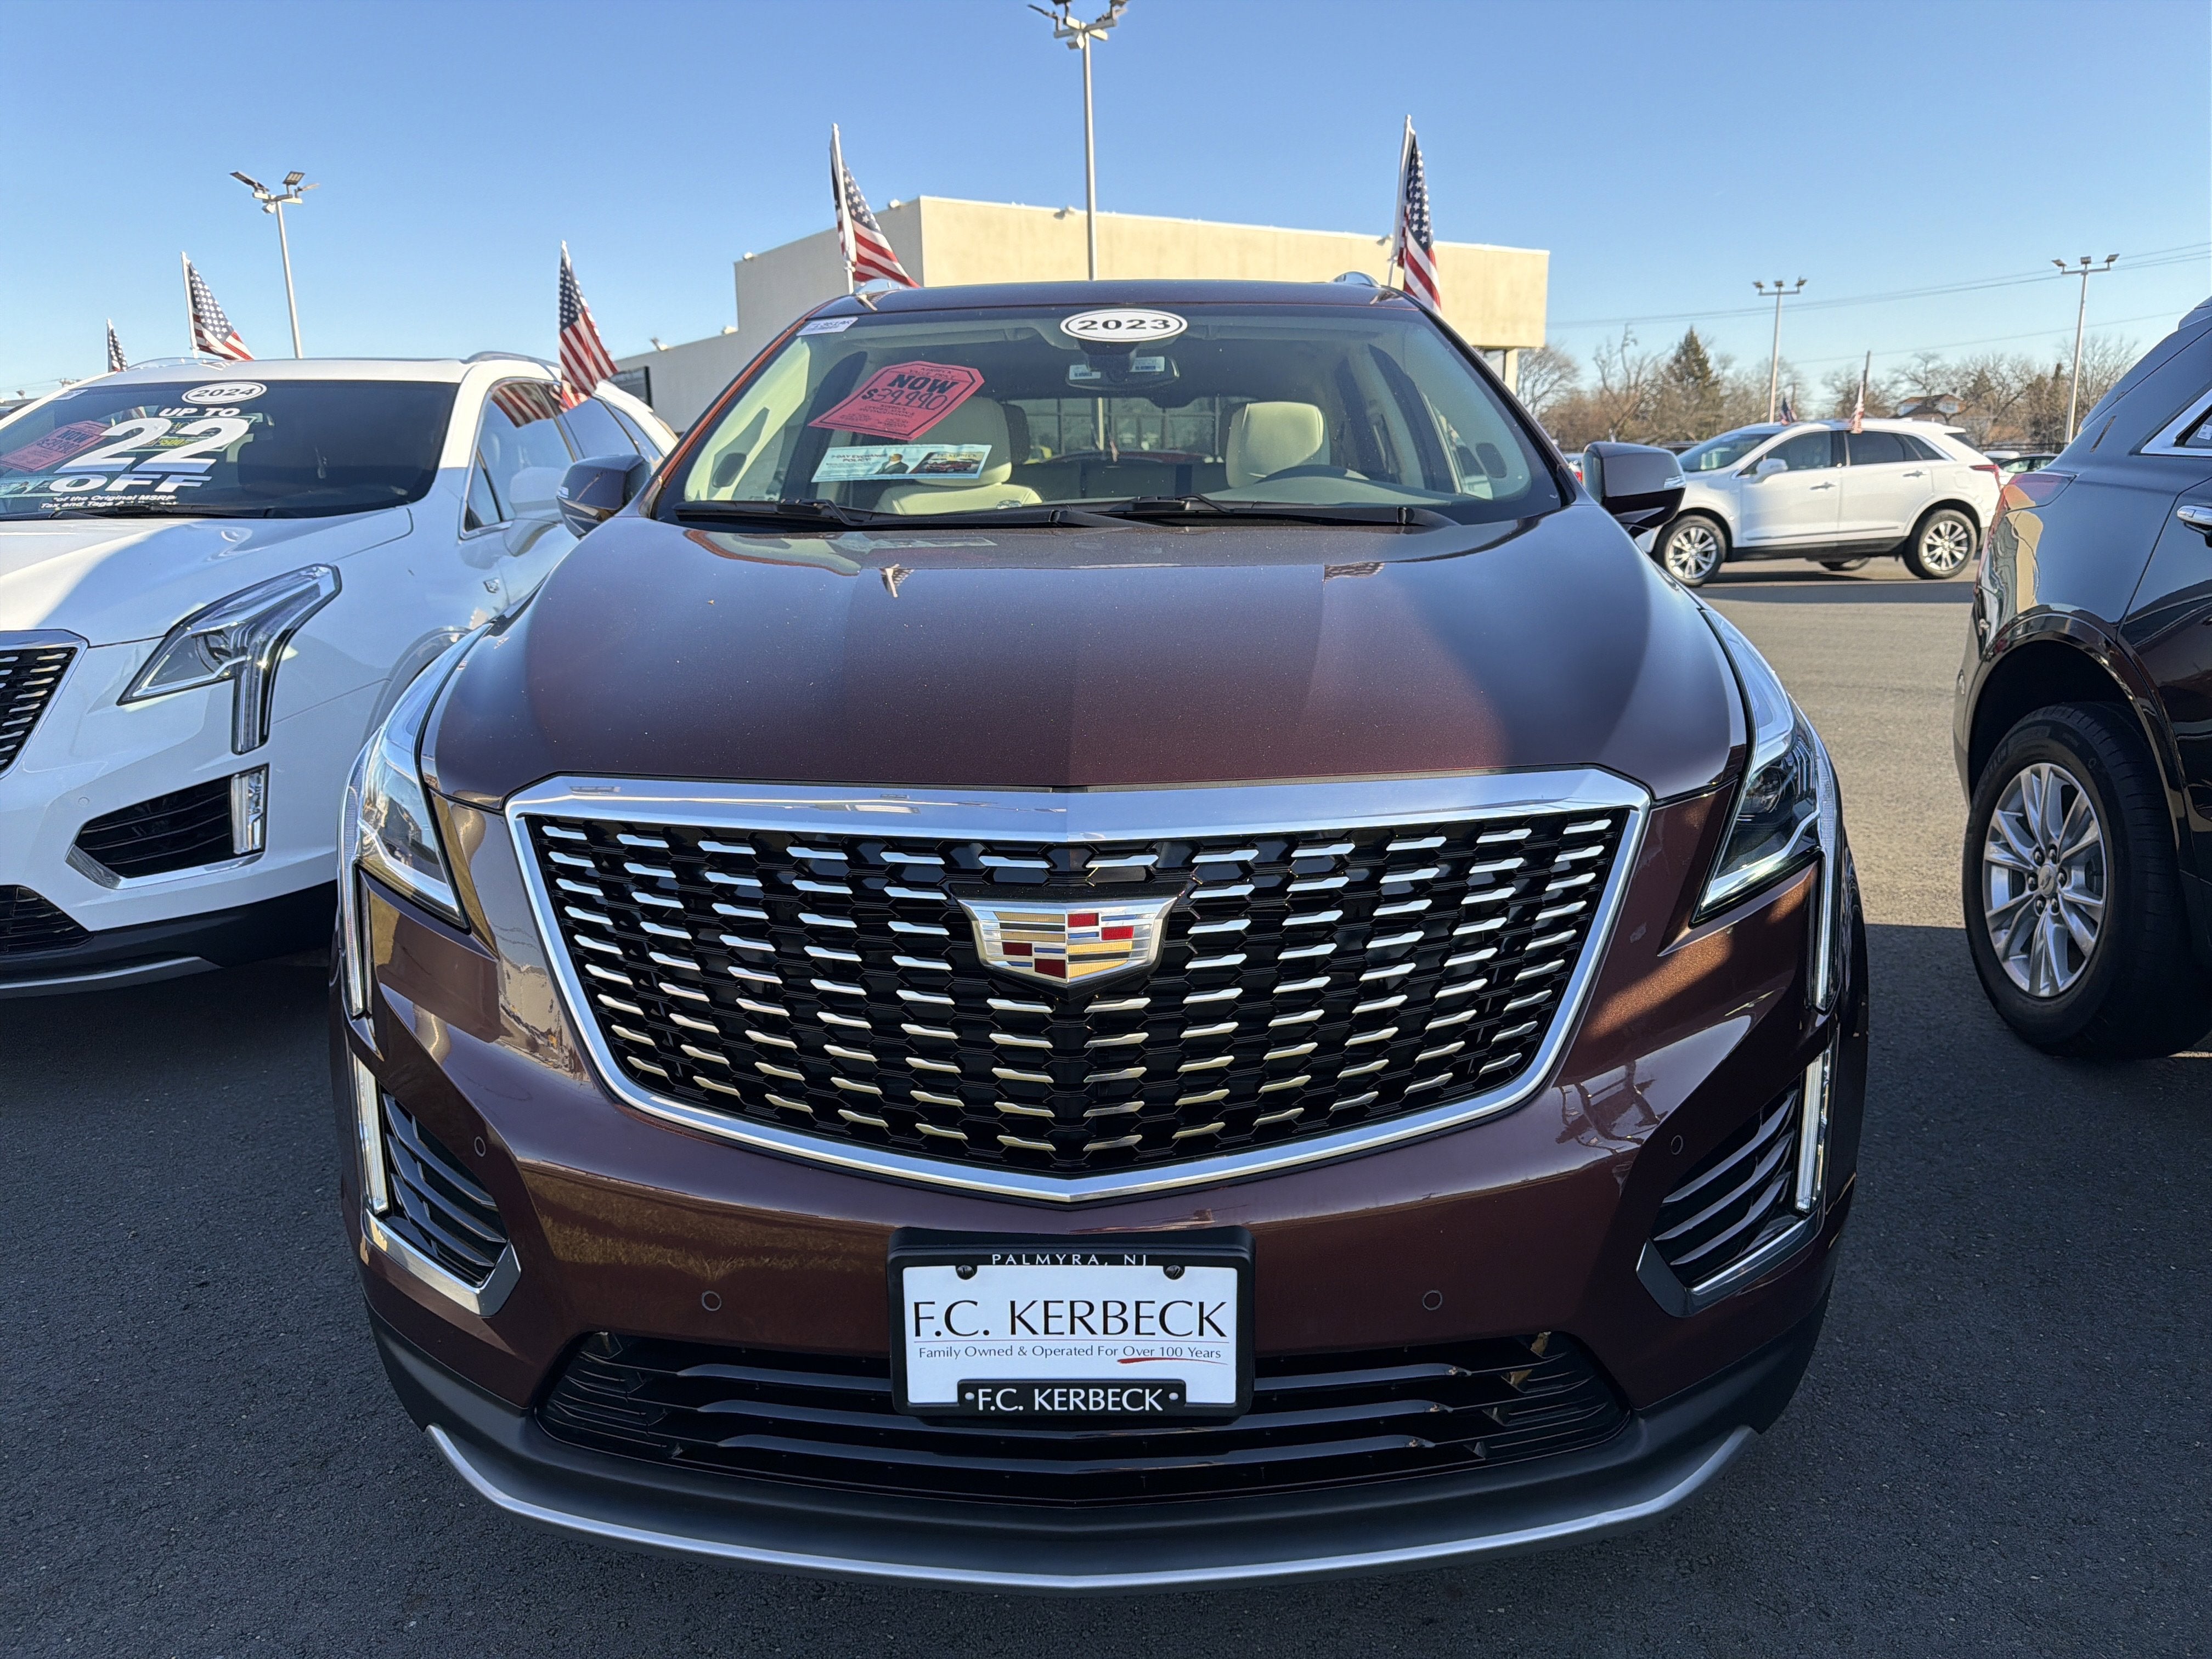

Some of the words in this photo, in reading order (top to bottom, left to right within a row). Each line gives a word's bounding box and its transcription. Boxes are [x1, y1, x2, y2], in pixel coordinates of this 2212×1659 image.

[1077, 319, 1171, 330] 2023
[887, 374, 959, 394] NOW
[191, 388, 256, 397] 2024
[159, 408, 198, 416] UP
[204, 408, 240, 417] TO
[53, 417, 250, 473] 22
[49, 474, 212, 493] OFF
[992, 1254, 1108, 1266] PALMYRA,
[1124, 1254, 1146, 1266] NJ
[913, 1300, 990, 1338] F.C.
[1009, 1300, 1227, 1338] KERBECK
[919, 1346, 961, 1359] Family
[965, 1345, 1013, 1357] Owned
[1018, 1346, 1028, 1356] &
[1032, 1345, 1093, 1358] Operated
[1098, 1346, 1118, 1357] For
[1122, 1345, 1155, 1357] Over
[1159, 1347, 1183, 1357] 100
[1188, 1347, 1221, 1359] Years
[978, 1387, 1024, 1412] F.C.
[1034, 1388, 1164, 1412] KERBECK
